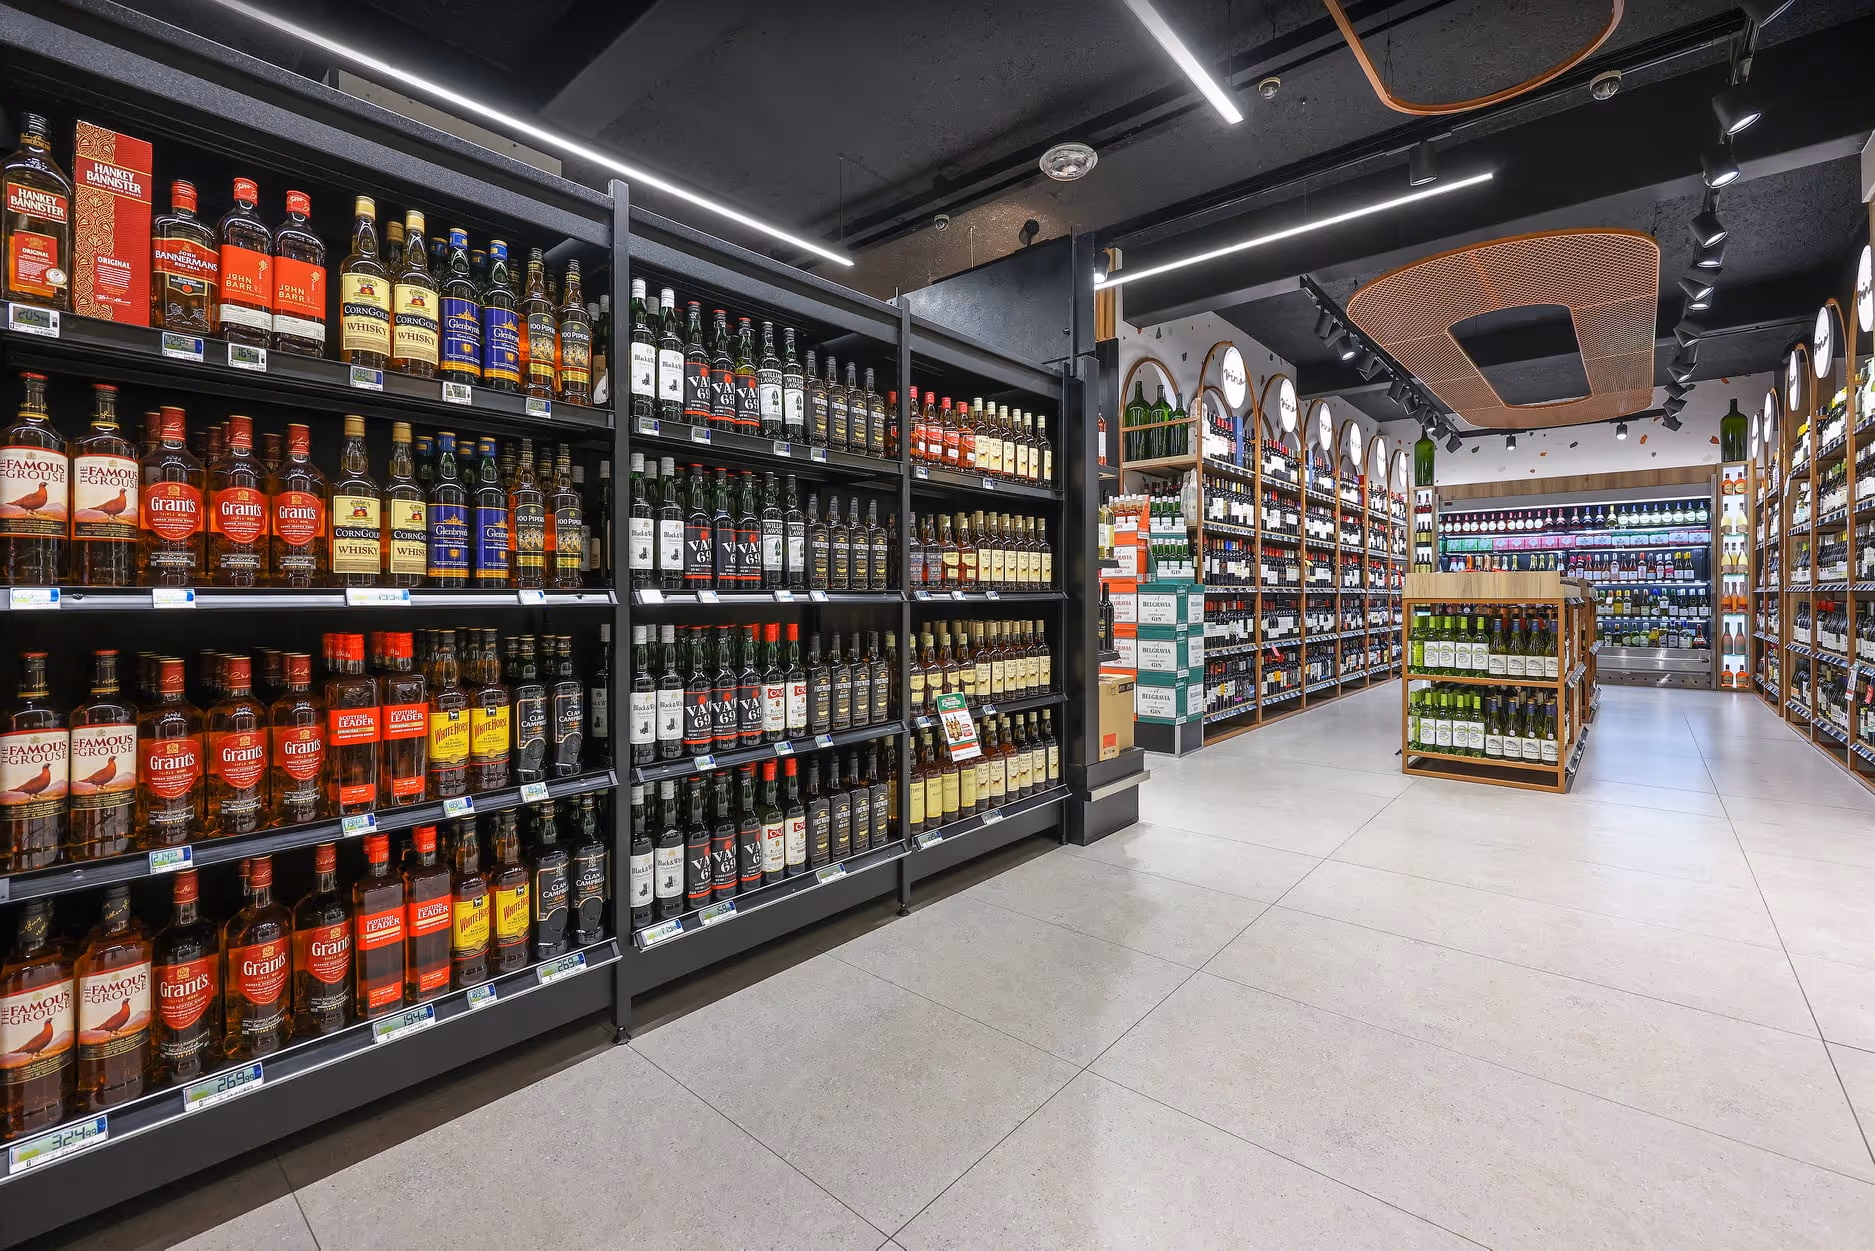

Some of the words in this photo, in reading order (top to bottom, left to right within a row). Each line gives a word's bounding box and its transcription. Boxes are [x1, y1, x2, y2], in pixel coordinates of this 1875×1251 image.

[94, 162, 135, 183] HANKEY
[86, 169, 142, 195] BANNISTER
[17, 188, 57, 206] HANKEY
[10, 195, 64, 217] BANNISTER
[22, 247, 49, 258] ORIGINAL
[97, 255, 131, 269] ORIGINAL
[155, 249, 218, 272] BANNERMANS
[226, 272, 252, 284] JOHN
[279, 283, 305, 296] JOHN
[347, 322, 388, 336] WHISKY
[397, 331, 436, 346] WHISKY
[696, 388, 711, 400] 69
[720, 394, 735, 405] 69
[744, 398, 759, 410] 69
[5, 458, 65, 474] FAMOUS
[88, 466, 138, 480] FAMOUS
[5, 468, 65, 483] GROUSE
[80, 465, 88, 484] THE
[151, 496, 197, 513] Grant's
[221, 501, 263, 517] Grant's
[278, 505, 317, 520] Grant's
[393, 530, 427, 541] CORNGO
[338, 545, 379, 556] WHISKY
[696, 551, 712, 564] 69
[745, 552, 761, 565] 69
[1142, 647, 1171, 655] BELGRAVIA
[1141, 694, 1171, 702] BELGRAVIA
[391, 713, 424, 723] LEADER
[566, 710, 581, 718] CLAN
[693, 713, 712, 728] 69
[719, 710, 737, 724] 69
[747, 707, 762, 721] 69
[338, 717, 374, 728] LEADER
[473, 720, 492, 739] WHITE
[79, 734, 134, 748] FAMOUS
[434, 728, 454, 745] WHITE
[8, 740, 67, 756] FAMOUS
[72, 738, 80, 756] THE
[78, 743, 133, 757] GROUSE
[222, 745, 263, 762] Grant's
[284, 738, 321, 755] Grant's
[1, 745, 9, 765] THE
[8, 750, 67, 766] GROUSE
[150, 752, 195, 771] Grant's
[720, 858, 737, 873] 69
[583, 872, 602, 881] CLAN
[551, 881, 567, 891] CLAN
[418, 902, 443, 913] SCOTTISH
[418, 905, 449, 920] LEADER
[503, 902, 521, 921] WHITE
[366, 914, 394, 926] SCOTTISH
[366, 917, 401, 933] LEADER
[459, 913, 479, 934] WHITE
[479, 906, 490, 920] HORS
[243, 951, 286, 977] Grant's
[91, 971, 147, 995] FAMOUS
[160, 972, 210, 998] Grant's
[84, 985, 92, 1004] THE
[91, 982, 147, 1004] GROUSE
[10, 988, 70, 1017] FAMOUS
[1, 1007, 10, 1026] THE
[9, 1000, 70, 1026] GROUSE
